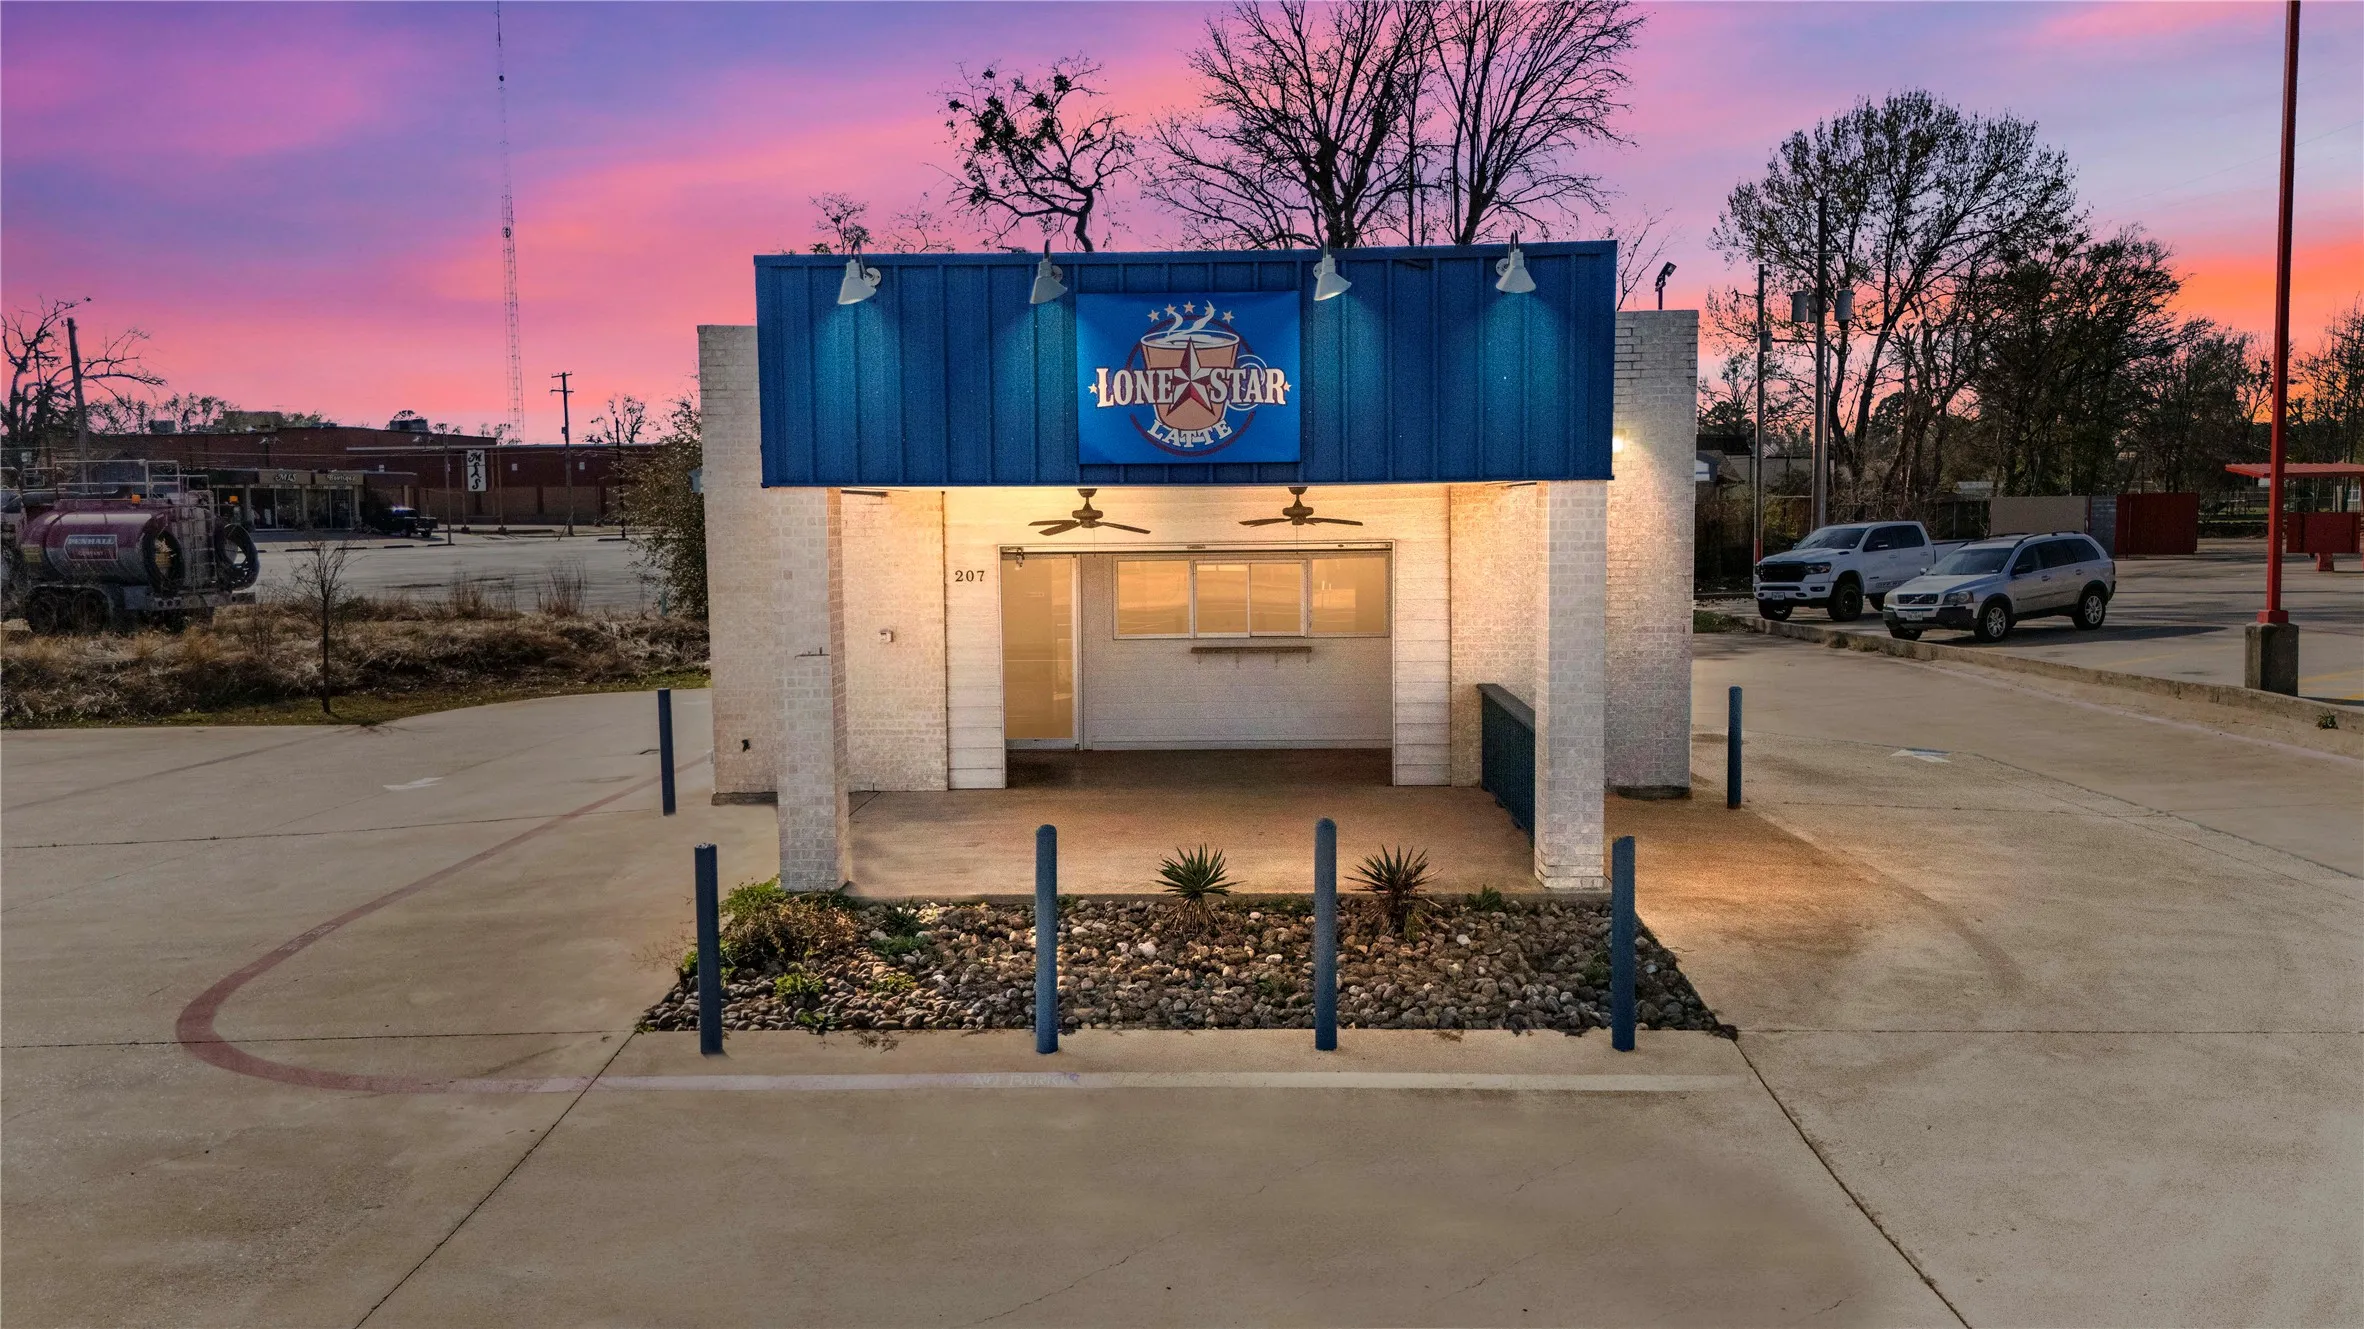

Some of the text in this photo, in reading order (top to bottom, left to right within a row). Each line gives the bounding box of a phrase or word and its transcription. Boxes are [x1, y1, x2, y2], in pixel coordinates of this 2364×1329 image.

[1096, 367, 1287, 408] LONE STAR
[1147, 419, 1233, 448] LATTE
[955, 570, 985, 582] 207
